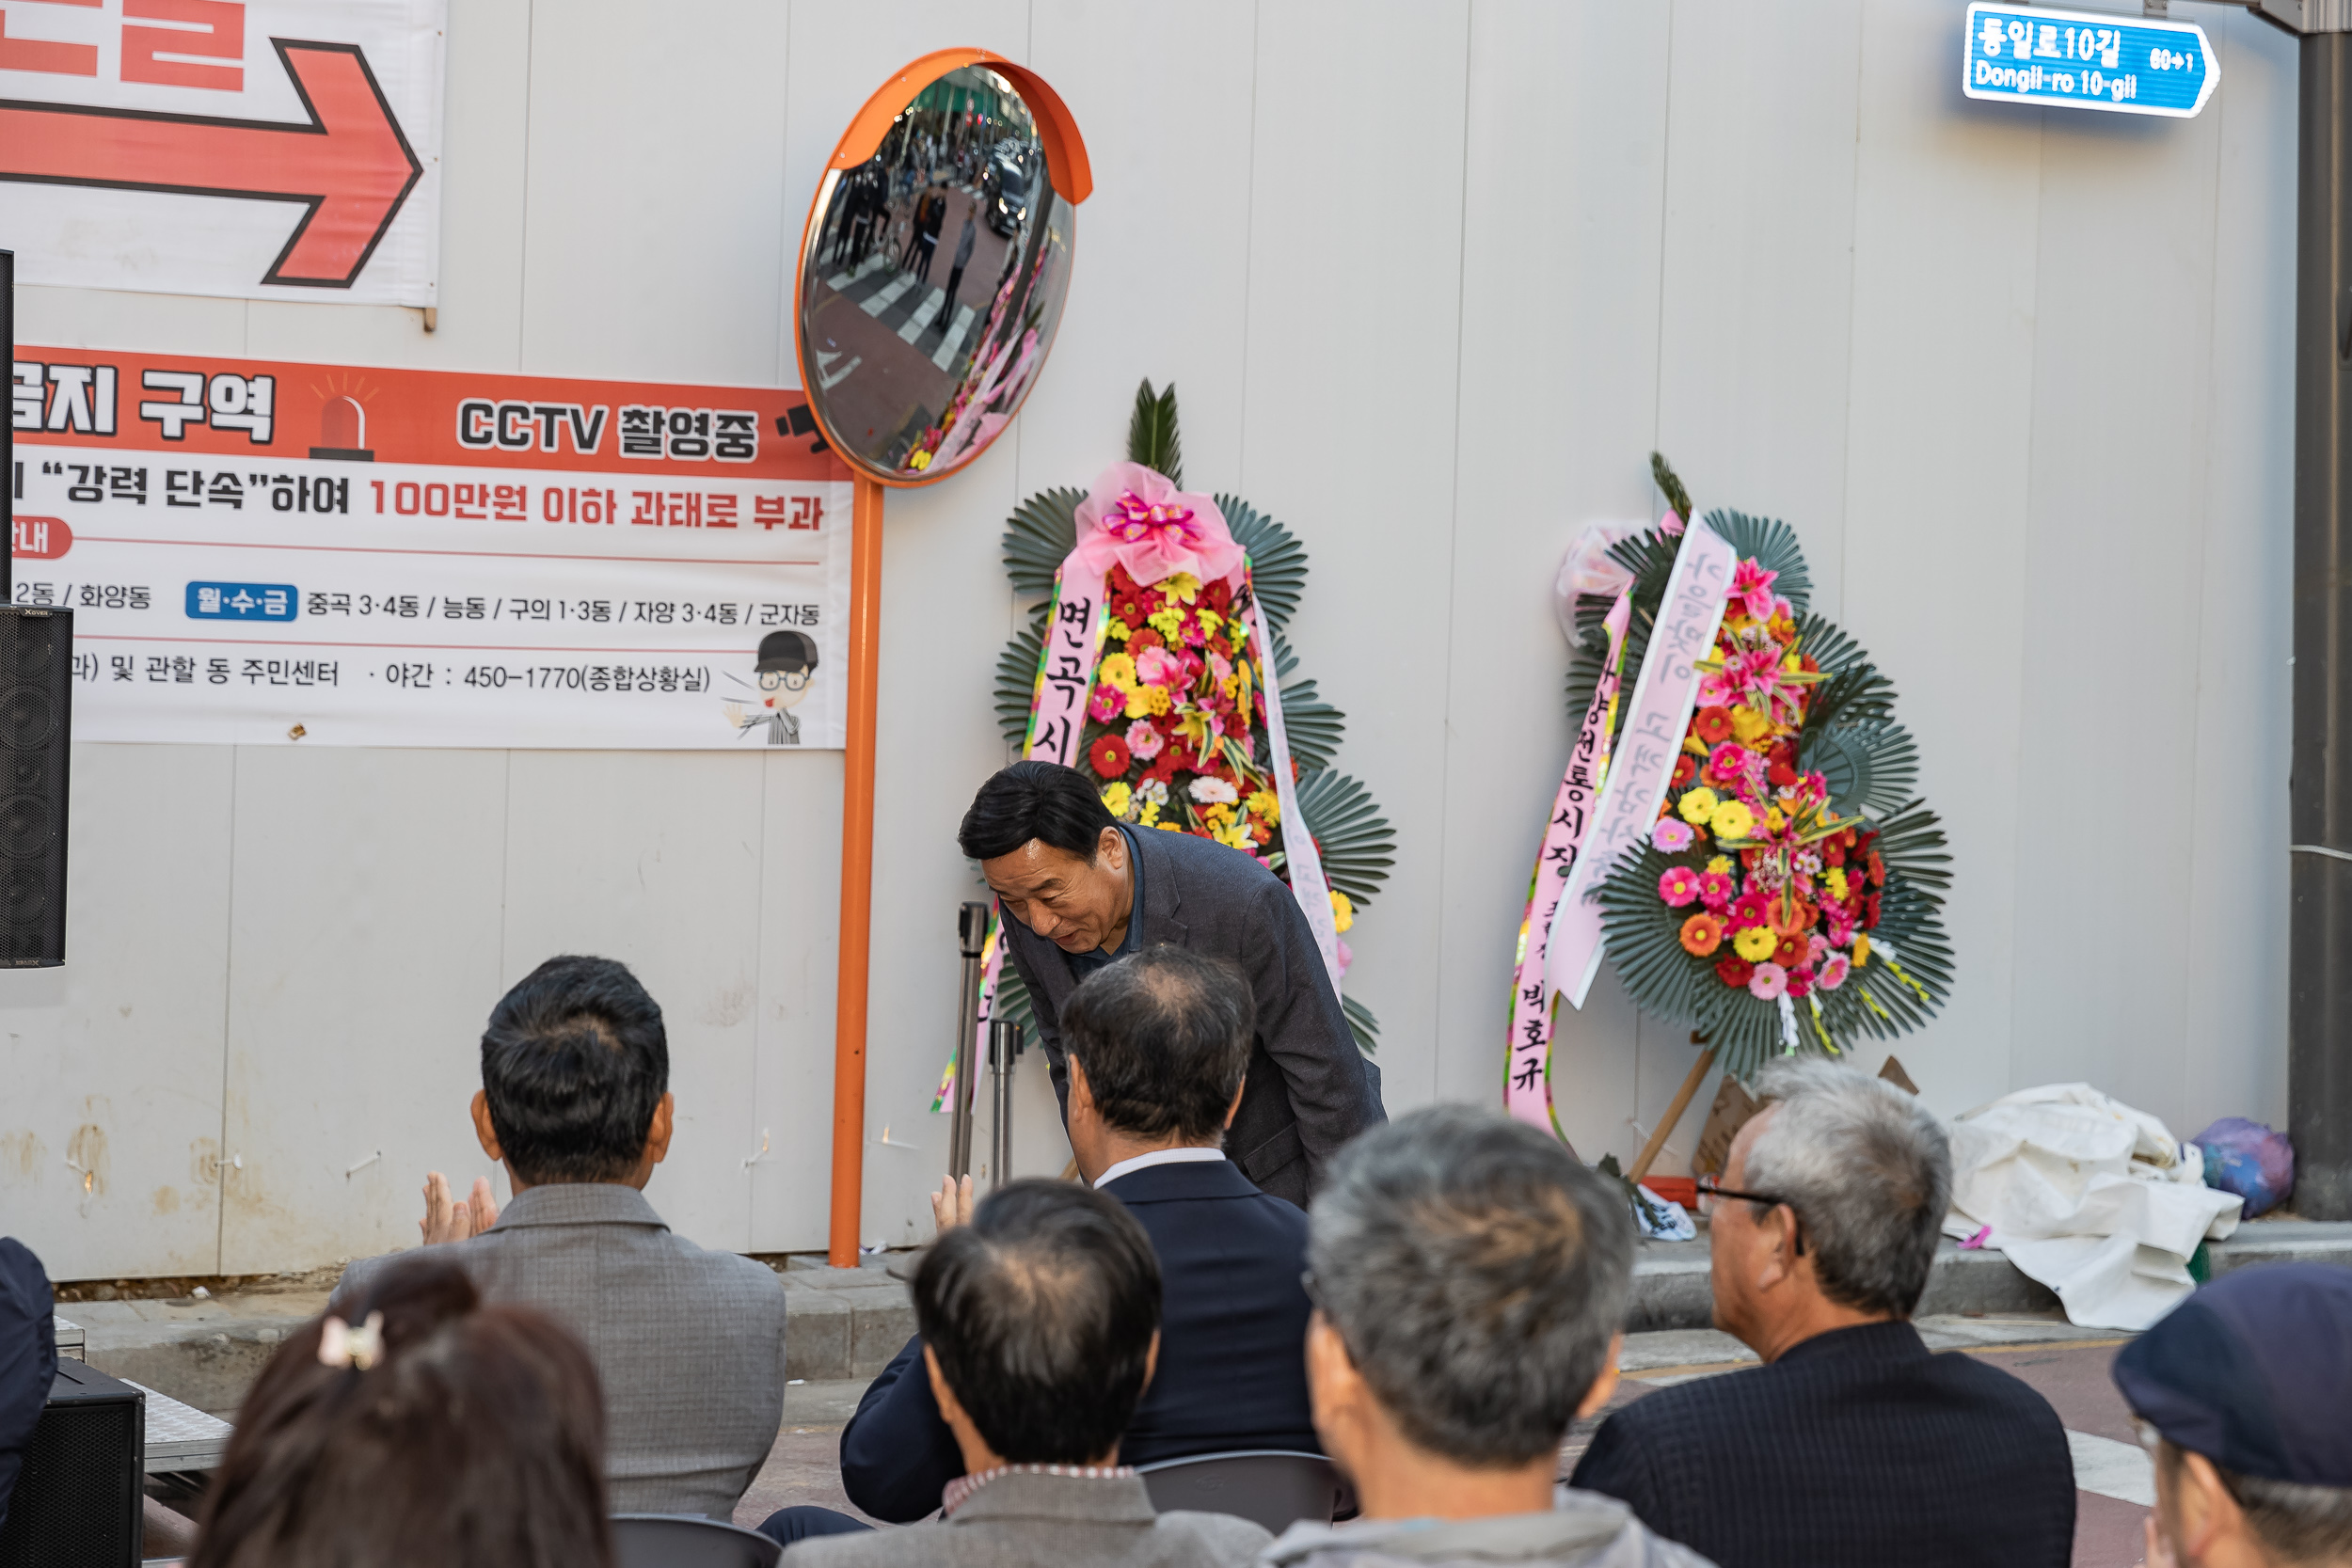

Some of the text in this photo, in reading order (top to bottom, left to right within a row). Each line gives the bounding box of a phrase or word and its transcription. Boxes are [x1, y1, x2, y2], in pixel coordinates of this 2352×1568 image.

[1978, 17, 2122, 69] 동일로10길
[1976, 60, 2137, 103] Dongil-ro 10-gil
[140, 370, 275, 444] 구역
[460, 400, 758, 461] CCTV 촬영중
[370, 481, 528, 522] 100만원
[543, 487, 617, 525] 이하
[630, 491, 739, 530] 과태로
[754, 496, 824, 531] 부과
[79, 583, 151, 610] 화양동
[197, 587, 288, 616] 월·수·금
[307, 592, 352, 616] 중곡
[358, 594, 420, 618] 3·4동
[442, 597, 485, 620] 능동
[508, 598, 551, 622] 구의
[558, 600, 612, 624] 1·3동
[633, 601, 675, 626] 자양
[682, 603, 739, 626] 3·4동
[759, 603, 820, 626] 군자동
[111, 655, 134, 681] 및
[146, 655, 196, 684] 관할
[206, 657, 231, 684] 동
[241, 658, 339, 687] 주민센터
[386, 661, 434, 689] 야간
[1033, 596, 1090, 764] 면곡시
